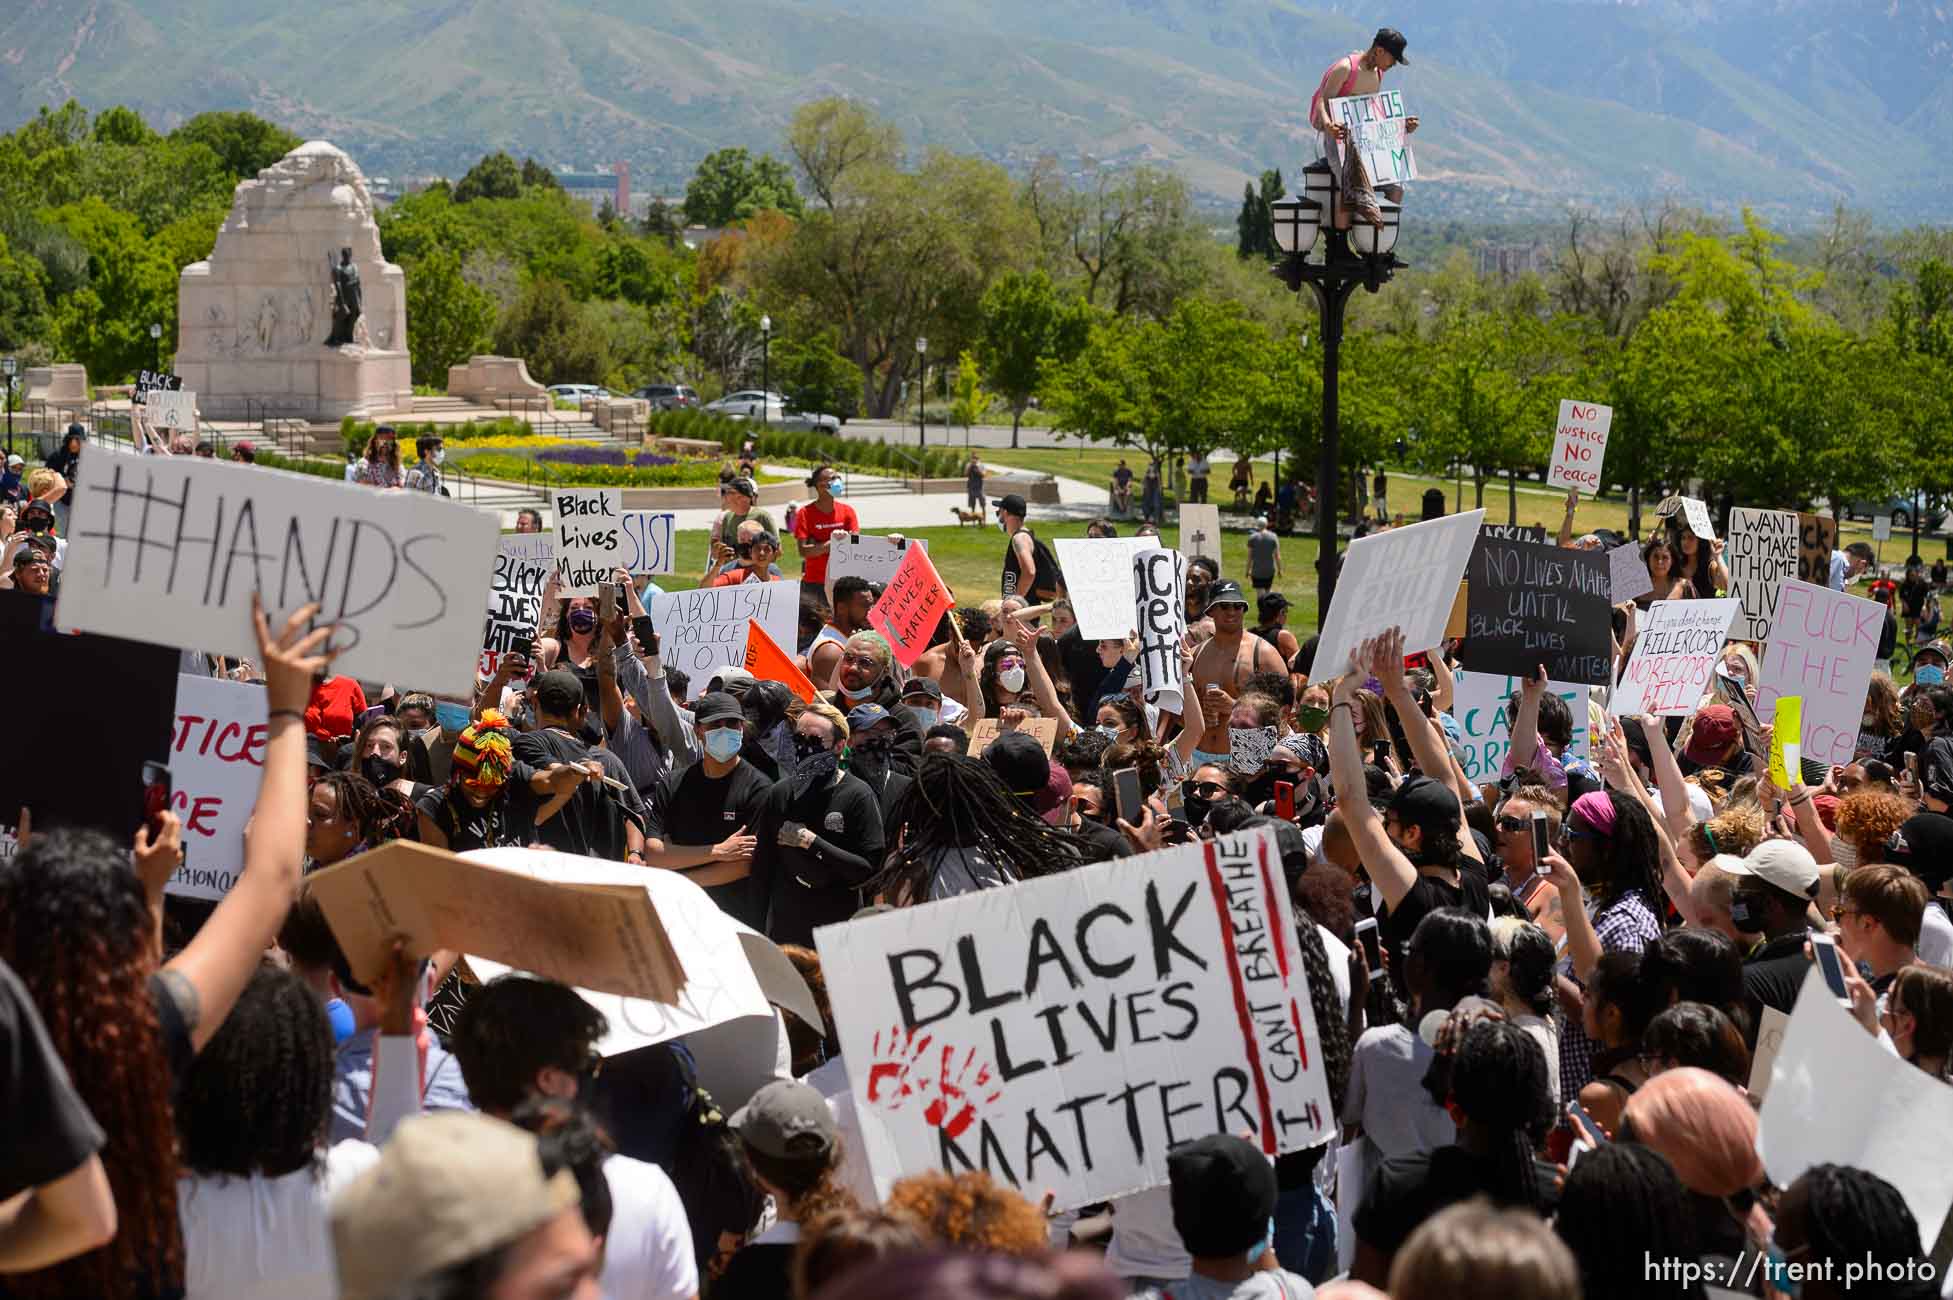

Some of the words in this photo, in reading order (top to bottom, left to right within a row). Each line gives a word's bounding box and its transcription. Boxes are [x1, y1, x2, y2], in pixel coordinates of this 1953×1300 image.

[140, 369, 173, 390] BLACK
[1572, 405, 1597, 421] NO
[1565, 442, 1592, 463] NO
[1552, 464, 1598, 488] Peace
[557, 491, 616, 518] Black
[561, 525, 618, 551] Lives
[1731, 510, 1737, 531] I
[1741, 512, 1796, 534] WANT
[80, 465, 447, 630] #HANDS
[1731, 532, 1753, 554] TO
[1758, 535, 1798, 559] MAKE
[491, 554, 546, 596] BLACK
[556, 556, 619, 588] Matter
[1485, 546, 1519, 586] NO
[1524, 551, 1563, 588] LIVES
[1731, 554, 1746, 577] IT
[1751, 559, 1797, 582] HOME
[665, 588, 773, 625] ABOLISH
[880, 563, 915, 617] BLACK
[894, 577, 924, 621] LIVES
[900, 583, 941, 649] MATTER
[1508, 591, 1576, 624] UNTIL
[1778, 586, 1881, 648] FUCK
[674, 624, 742, 646] POLICE
[1470, 613, 1525, 639] BLACK
[1525, 631, 1566, 650] LIVES
[1552, 654, 1611, 678] MATTER
[1776, 639, 1849, 695] THE
[1218, 838, 1279, 983] BREATHE
[887, 879, 1208, 1030] BLACK
[990, 981, 1200, 1083] LIVES
[938, 1065, 1259, 1189] MATTER
[1275, 1100, 1315, 1136] I
